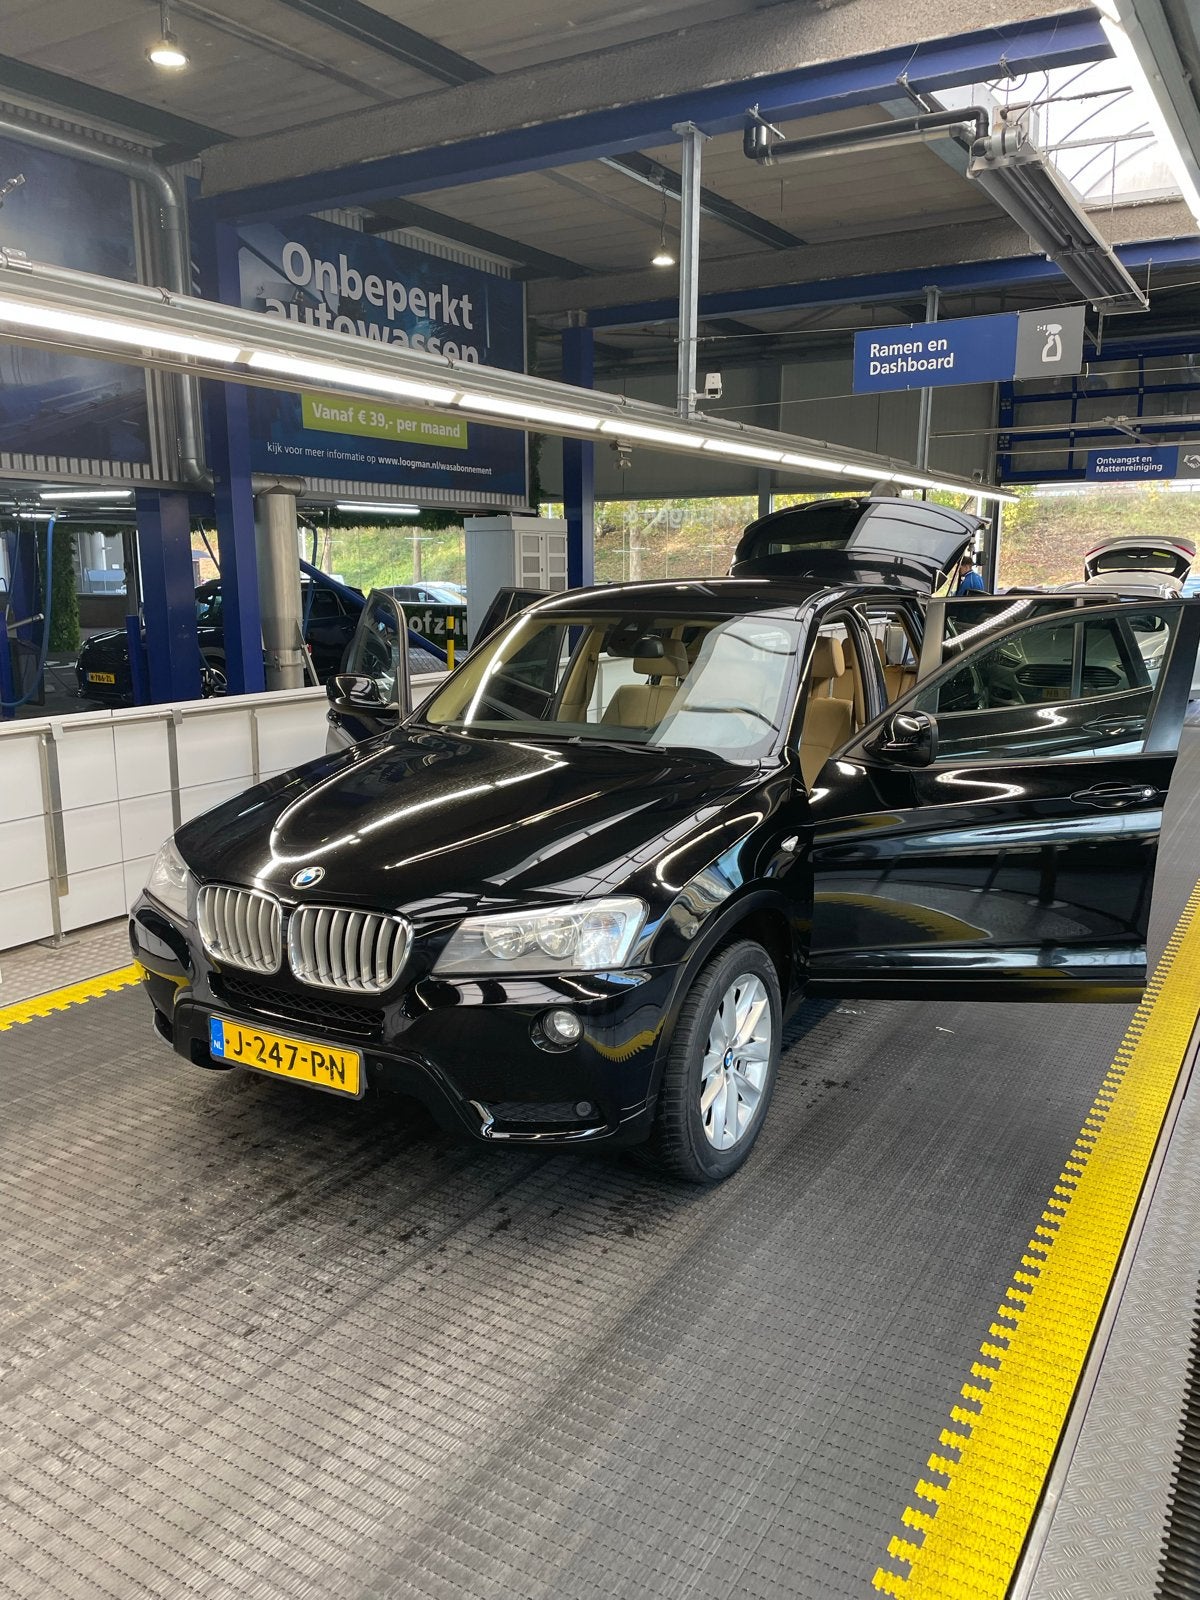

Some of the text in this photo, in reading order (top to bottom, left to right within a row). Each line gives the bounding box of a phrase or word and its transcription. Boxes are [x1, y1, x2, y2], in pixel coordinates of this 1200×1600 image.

[282, 241, 473, 330] Onbeperkt
[870, 338, 947, 358] Ramen en
[869, 352, 954, 376] Dashboard
[312, 402, 460, 438] Vanaf € 39,- per maand
[267, 442, 492, 475] kijk voor meer informatie op www.loogman.nl/wasabonnement
[1095, 463, 1163, 473] Mattenreiniging
[1096, 456, 1140, 465] Ontvangst
[213, 1040, 223, 1050] NL
[233, 1030, 345, 1085] J-247-PN
